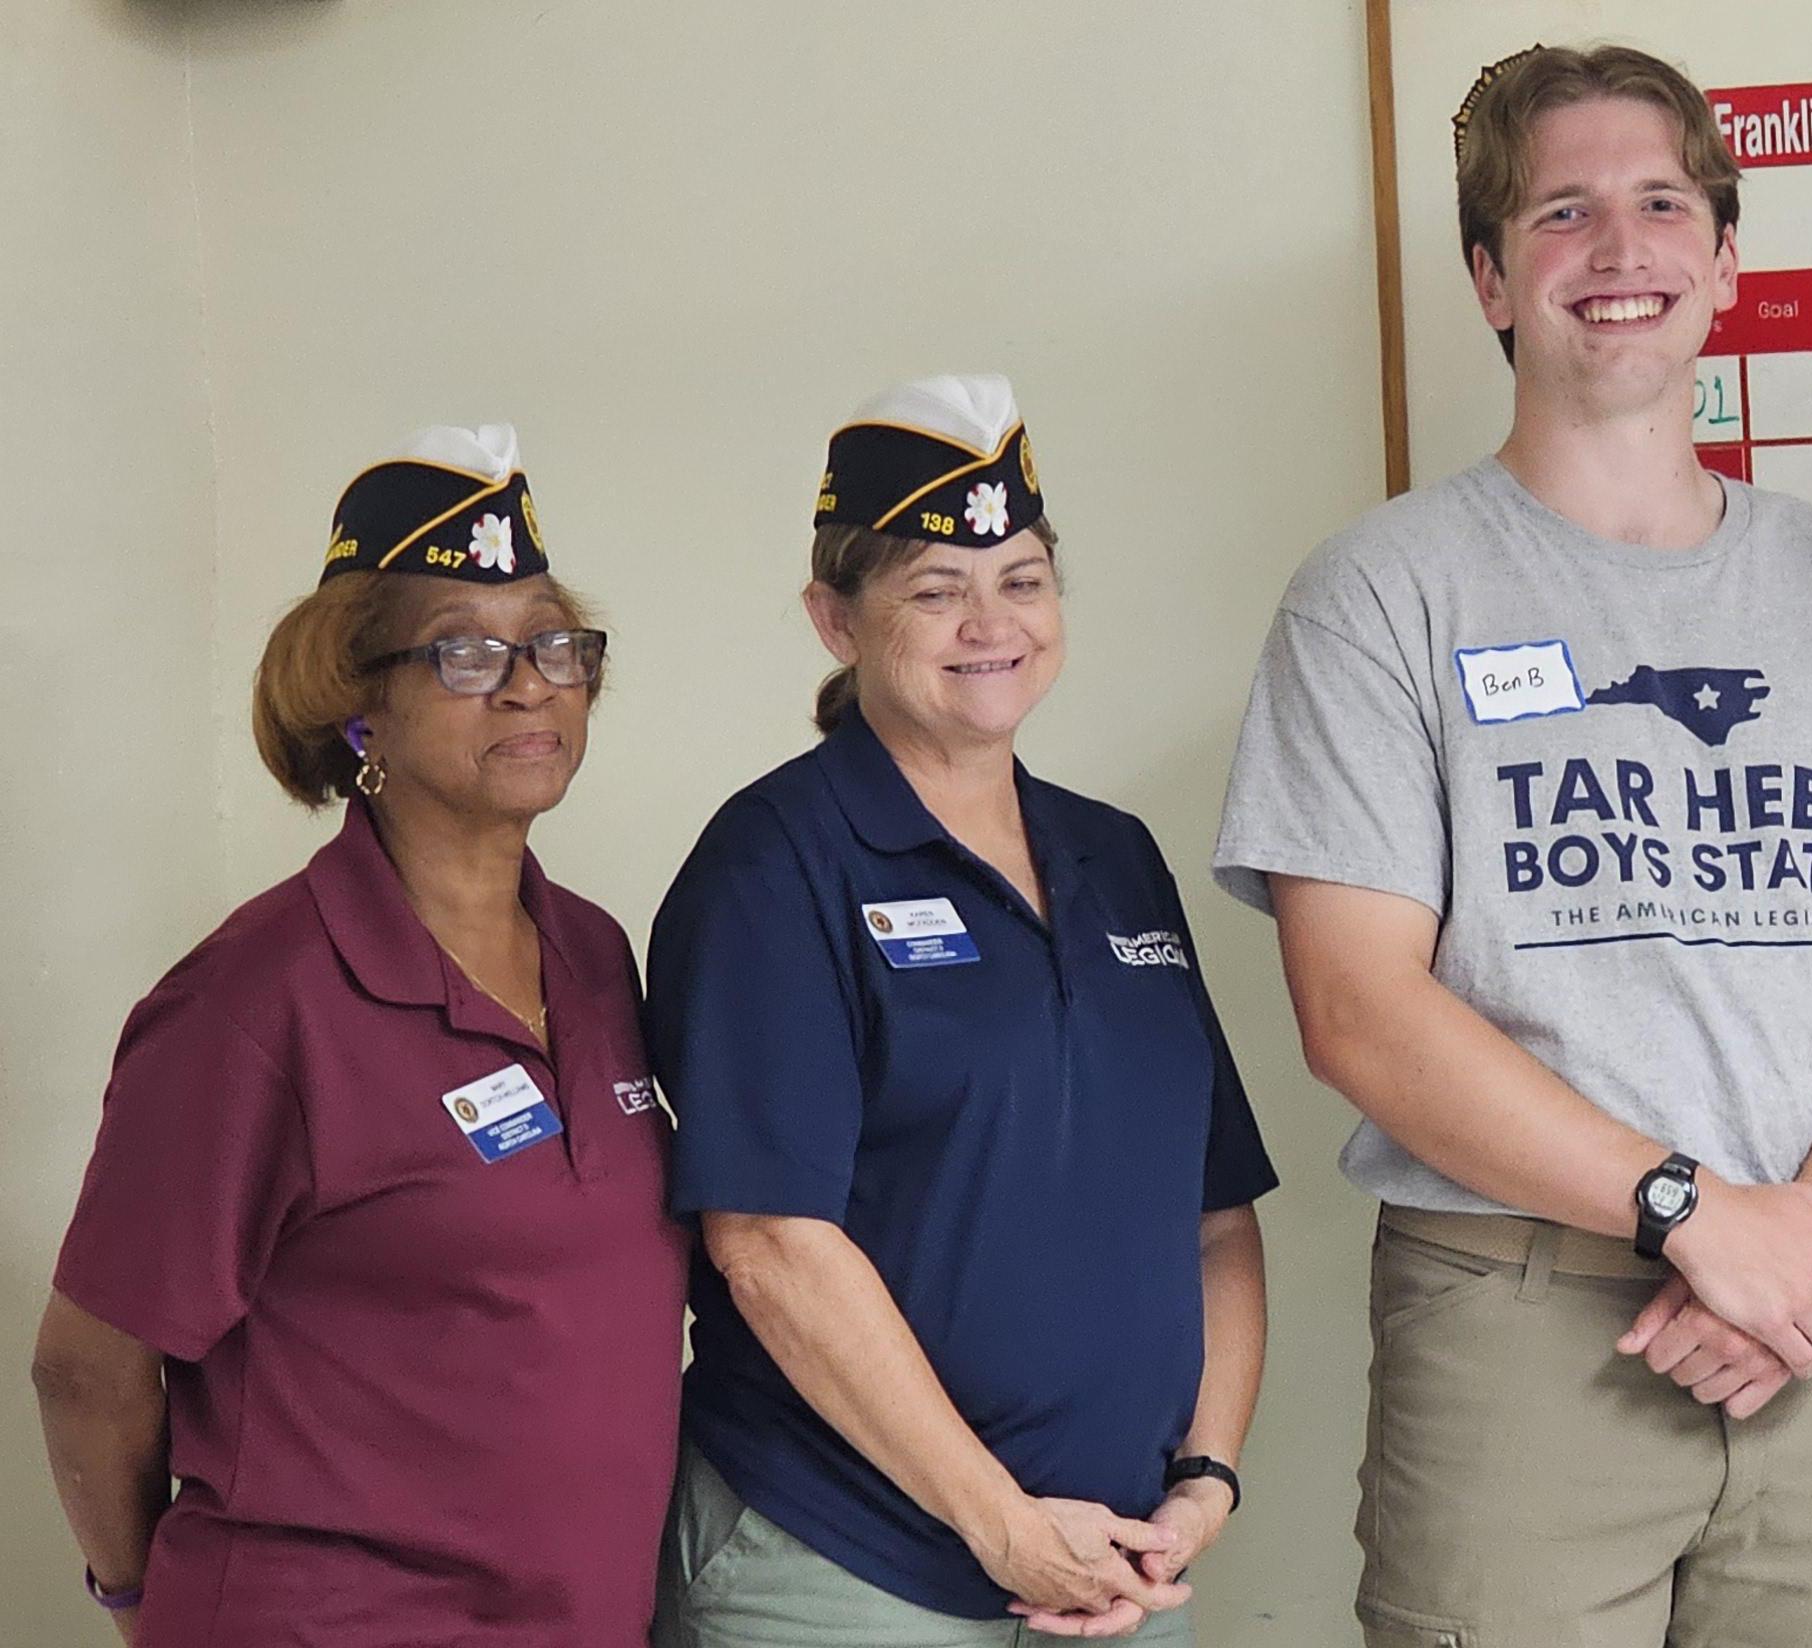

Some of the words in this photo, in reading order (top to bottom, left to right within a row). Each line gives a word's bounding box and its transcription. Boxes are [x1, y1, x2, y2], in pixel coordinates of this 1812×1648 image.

[1758, 300, 1799, 319] Goal
[920, 511, 955, 536] 138
[425, 545, 467, 569] 547
[1482, 672, 1522, 697] Ben
[1528, 667, 1545, 689] B
[1497, 757, 1660, 830] TAR
[1504, 831, 1672, 893] BOYS
[1552, 906, 1600, 927] THE
